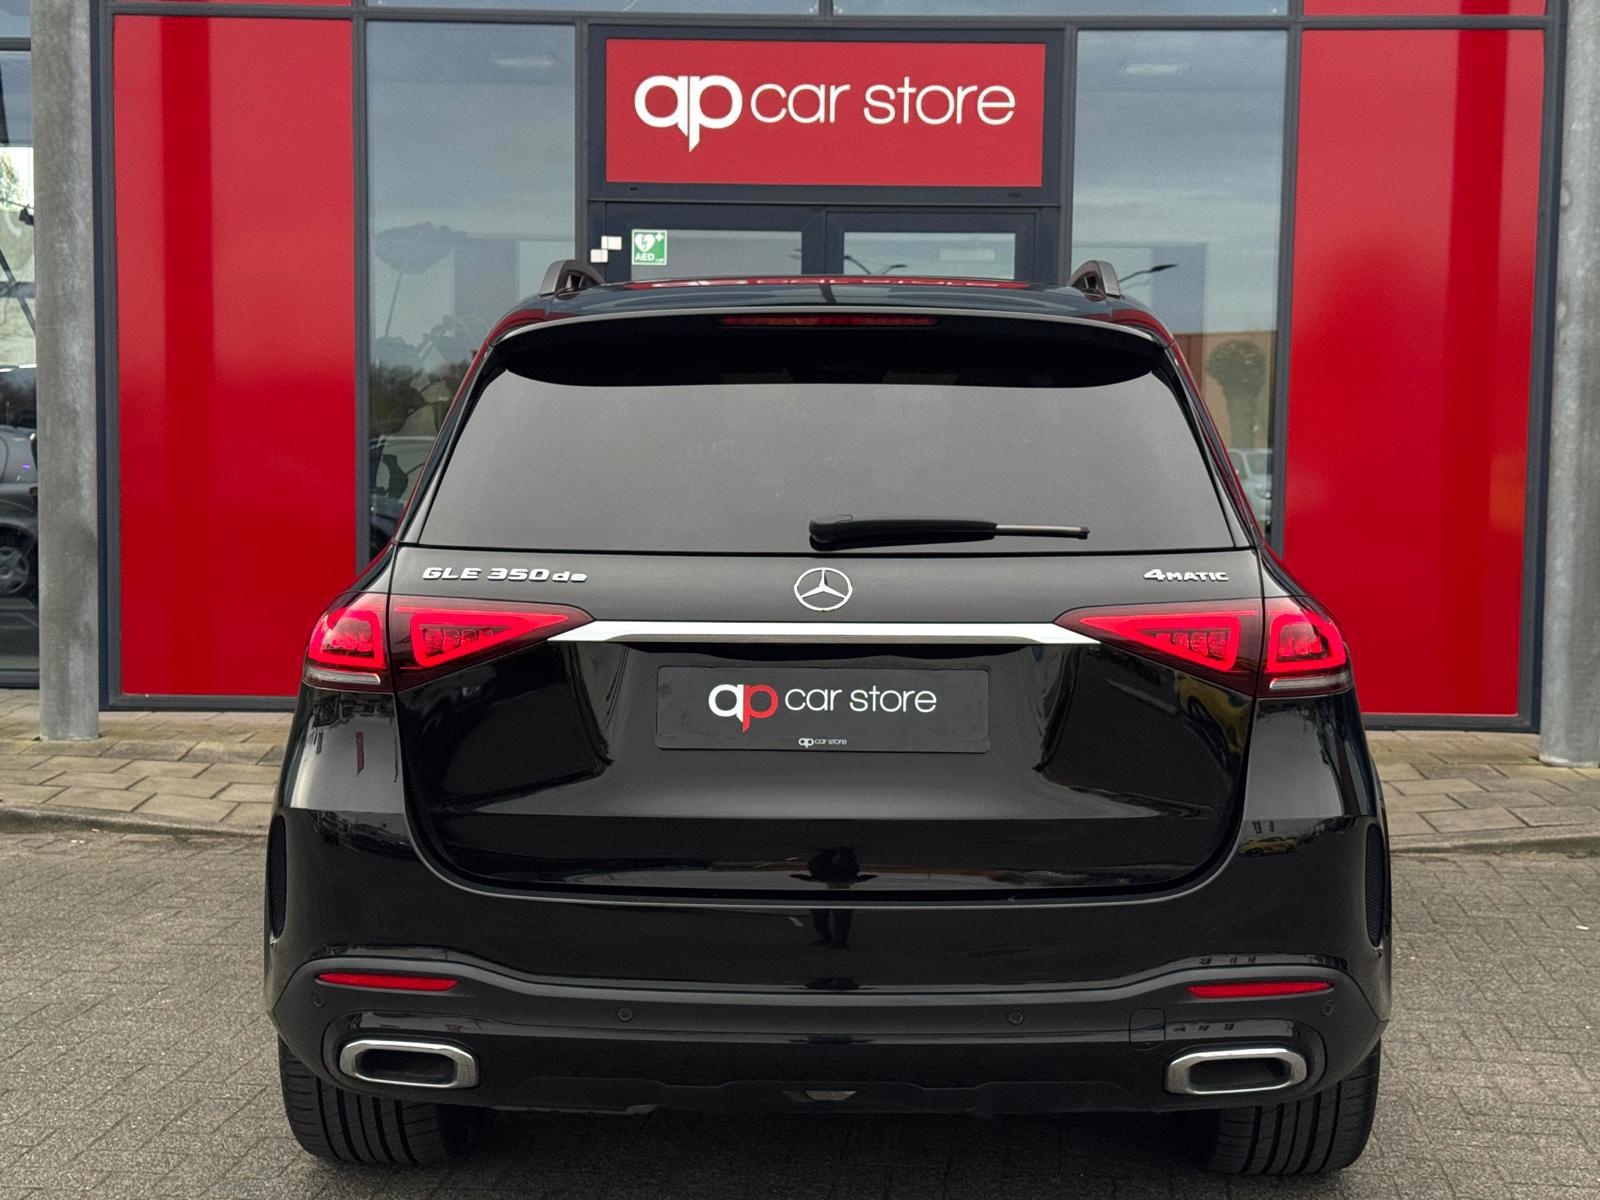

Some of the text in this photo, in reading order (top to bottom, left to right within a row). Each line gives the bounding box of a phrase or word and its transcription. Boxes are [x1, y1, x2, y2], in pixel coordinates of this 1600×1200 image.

[750, 83, 850, 124] car
[863, 76, 1016, 126] store
[635, 253, 656, 262] AED
[422, 567, 482, 581] GLE
[1143, 568, 1230, 581] 4MATIC
[784, 688, 843, 712] car
[849, 684, 938, 713] store
